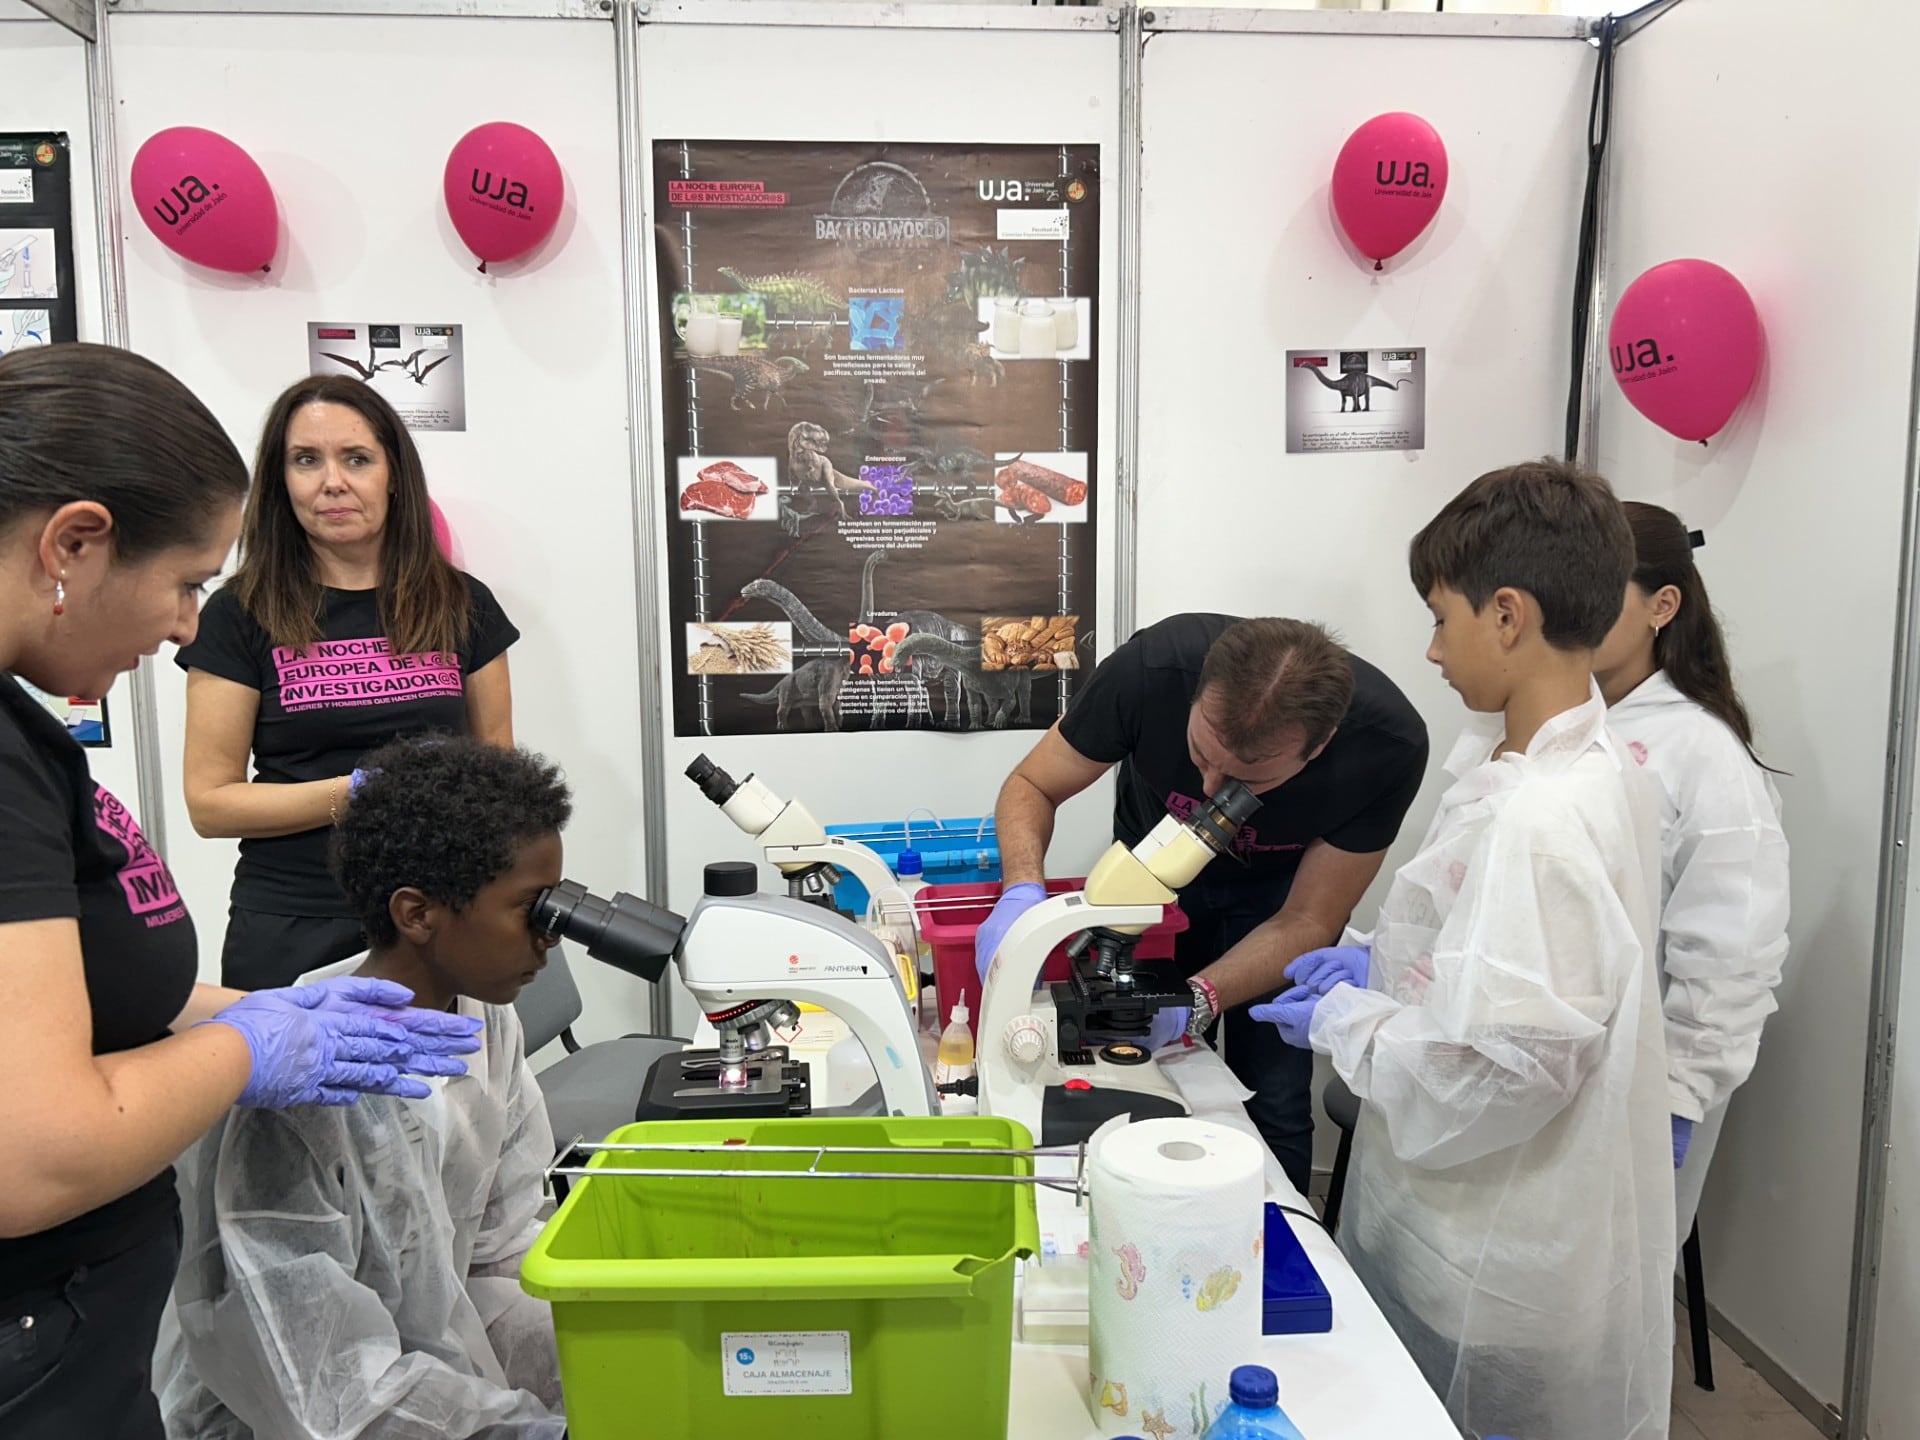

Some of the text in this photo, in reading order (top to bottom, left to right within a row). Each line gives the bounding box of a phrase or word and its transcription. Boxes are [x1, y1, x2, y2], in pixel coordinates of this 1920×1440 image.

[671, 182, 761, 191] LA NOCHE EUROPEA
[1374, 189, 1412, 197] Universidad
[469, 194, 507, 214] Universidad
[507, 209, 516, 217] de
[671, 193, 683, 201] DE
[705, 193, 783, 202] INVESTIGADOR@S
[176, 207, 206, 236] Universidad
[203, 203, 213, 212] de
[318, 640, 390, 659] NOCHE
[283, 660, 384, 683] EUROPEA
[389, 656, 417, 671] DE
[283, 672, 460, 702] INVESTIGADOR@S
[285, 702, 323, 714] MUJERES
[324, 701, 331, 709] Y
[331, 698, 374, 708] HOMBRES
[374, 697, 391, 705] QUE
[391, 694, 417, 703] HACEN
[418, 690, 446, 699] CIENCIA
[1172, 795, 1193, 813] LA
[743, 1370, 832, 1378] CAJA ALMACENAJE
